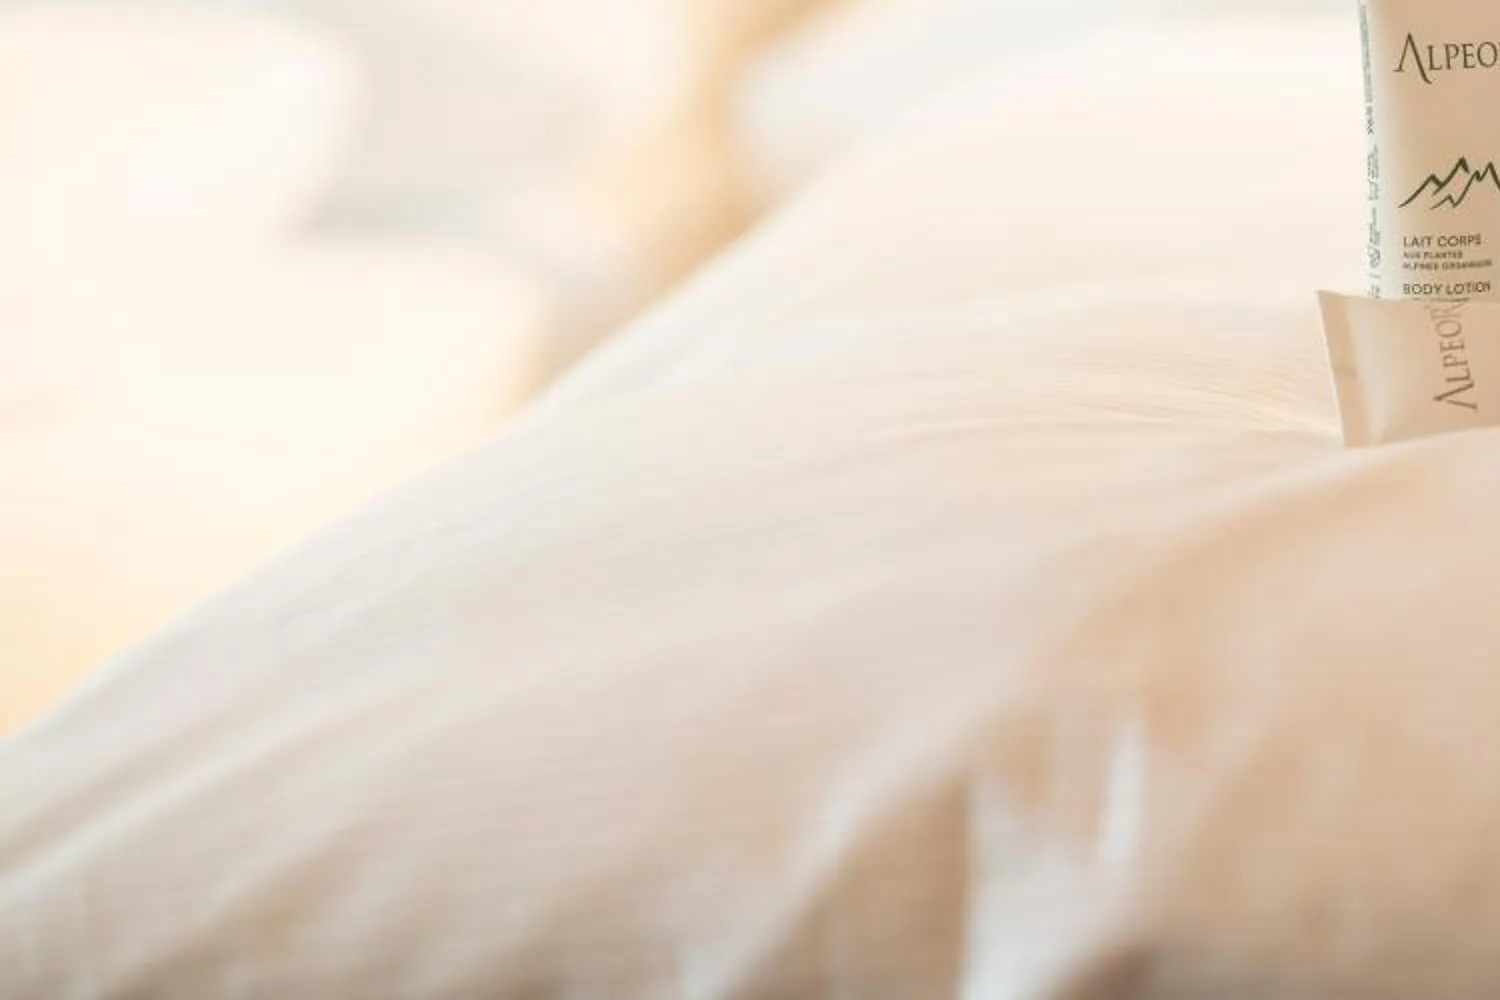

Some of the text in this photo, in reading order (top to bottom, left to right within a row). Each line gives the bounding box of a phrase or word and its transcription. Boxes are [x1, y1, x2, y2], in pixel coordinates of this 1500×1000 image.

[1402, 233, 1481, 248] LAIT CORPS
[1402, 280, 1491, 295] BODY LOTION
[1430, 302, 1477, 413] ALPEOR
